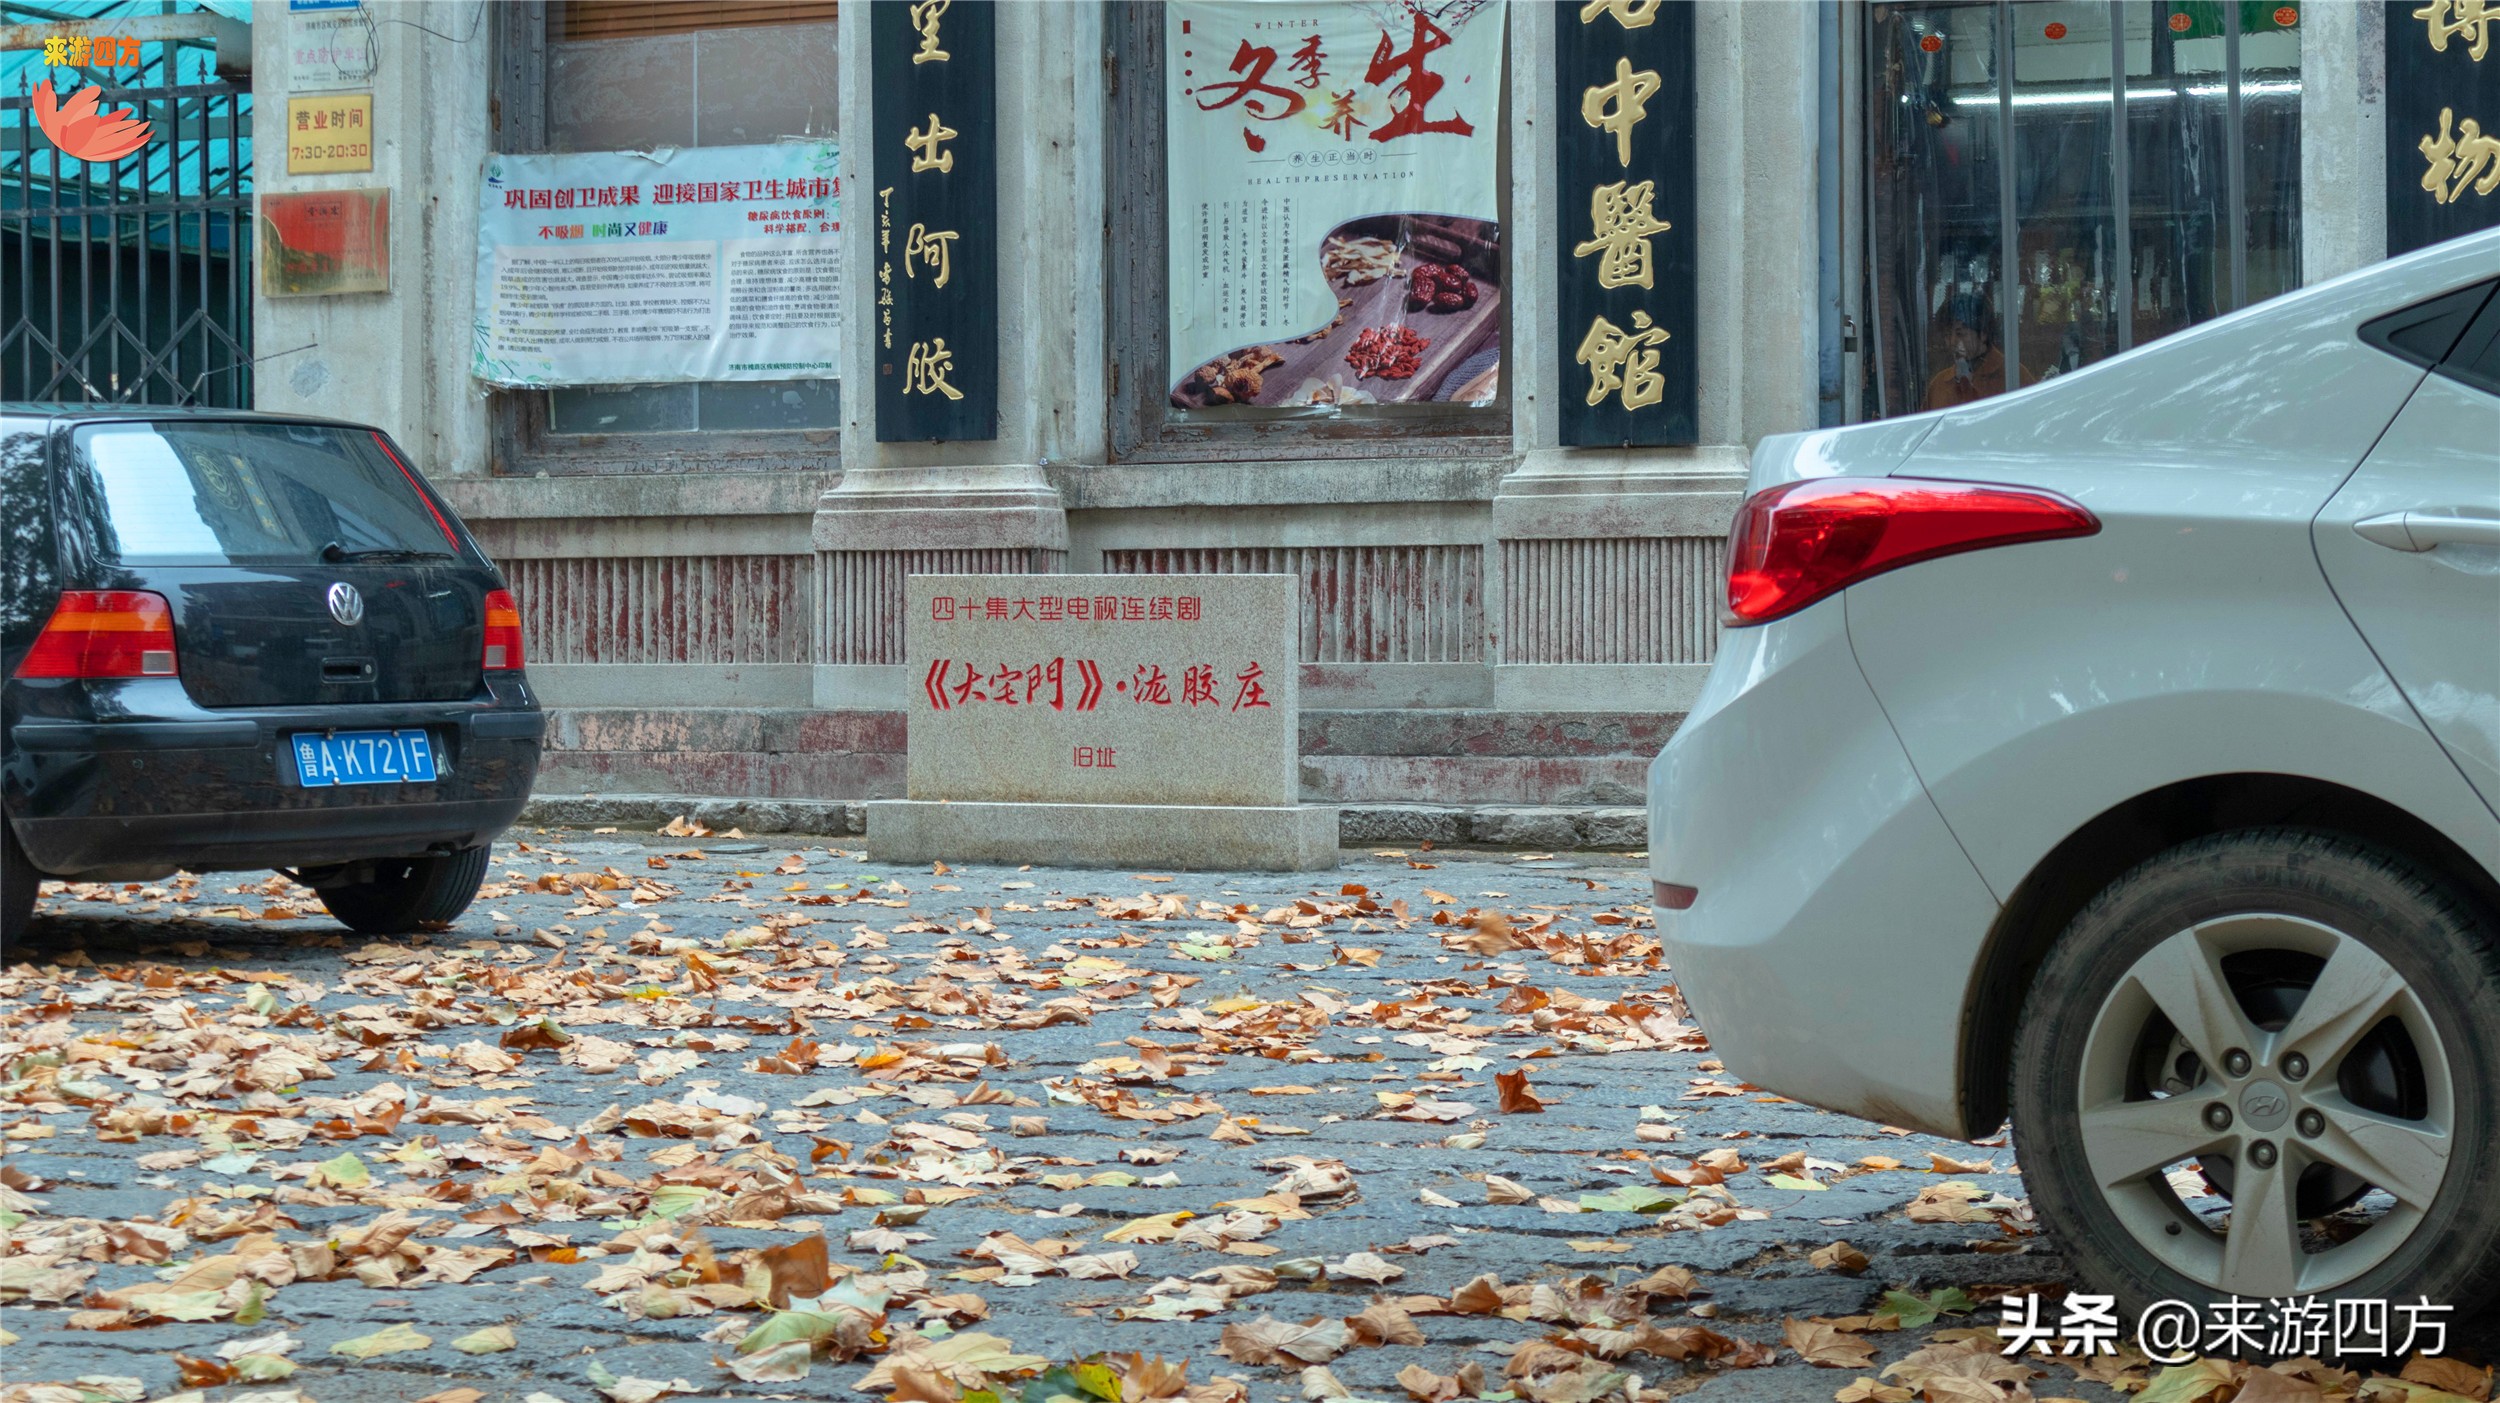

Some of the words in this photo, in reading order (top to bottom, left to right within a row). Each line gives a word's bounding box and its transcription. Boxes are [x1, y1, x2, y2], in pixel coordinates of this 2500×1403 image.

[1255, 18, 1319, 30] WINTER
[296, 108, 364, 131] 营业时间
[291, 143, 368, 160] 7:30-20:30
[1290, 149, 1376, 165] 养生正当时
[503, 184, 641, 211] 巩固创卫成果
[538, 223, 585, 240] 不吸烟
[592, 221, 668, 238] 时尚又健康
[932, 597, 1201, 622] 四十集大型电视连续剧
[1073, 746, 1117, 768] 旧址
